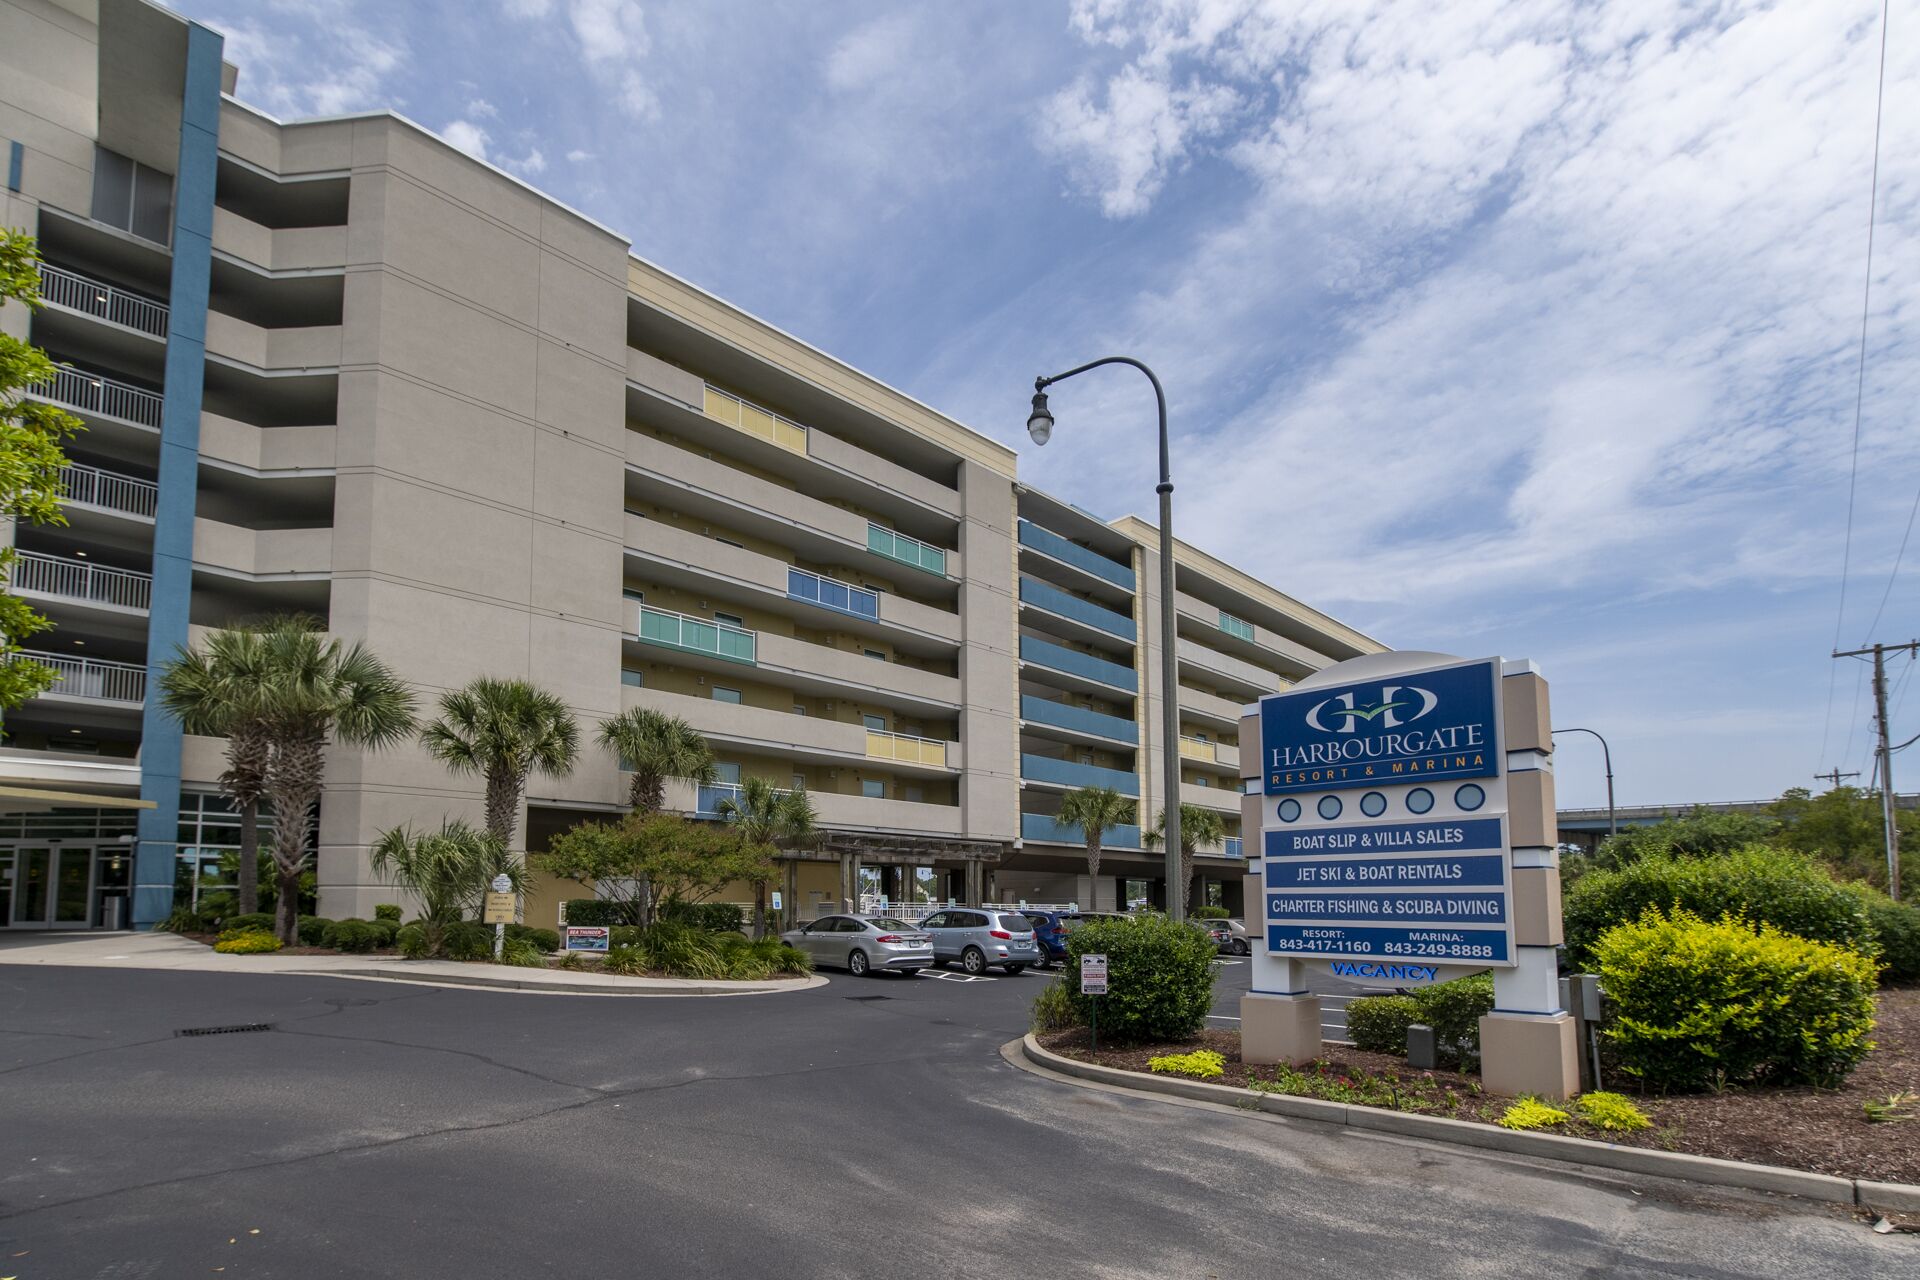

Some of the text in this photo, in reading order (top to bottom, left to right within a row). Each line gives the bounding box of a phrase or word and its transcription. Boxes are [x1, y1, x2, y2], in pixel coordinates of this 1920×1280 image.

[1272, 724, 1483, 767] HARBOURGATE
[1273, 755, 1483, 784] RESORT & MARINA
[1294, 829, 1463, 849] BOAT SLIP & VILLA SALES
[1297, 864, 1462, 881] JET SKI & BOAT RENTALS
[1272, 900, 1498, 915] CHARTER FISHING & SCUBA DIVING
[1302, 930, 1344, 939] RESORT:
[1409, 932, 1463, 942] MARINA:
[1280, 940, 1371, 952] 843-417-1160
[1384, 943, 1492, 957] 843-249-8888
[1330, 963, 1438, 981] VACANCY
